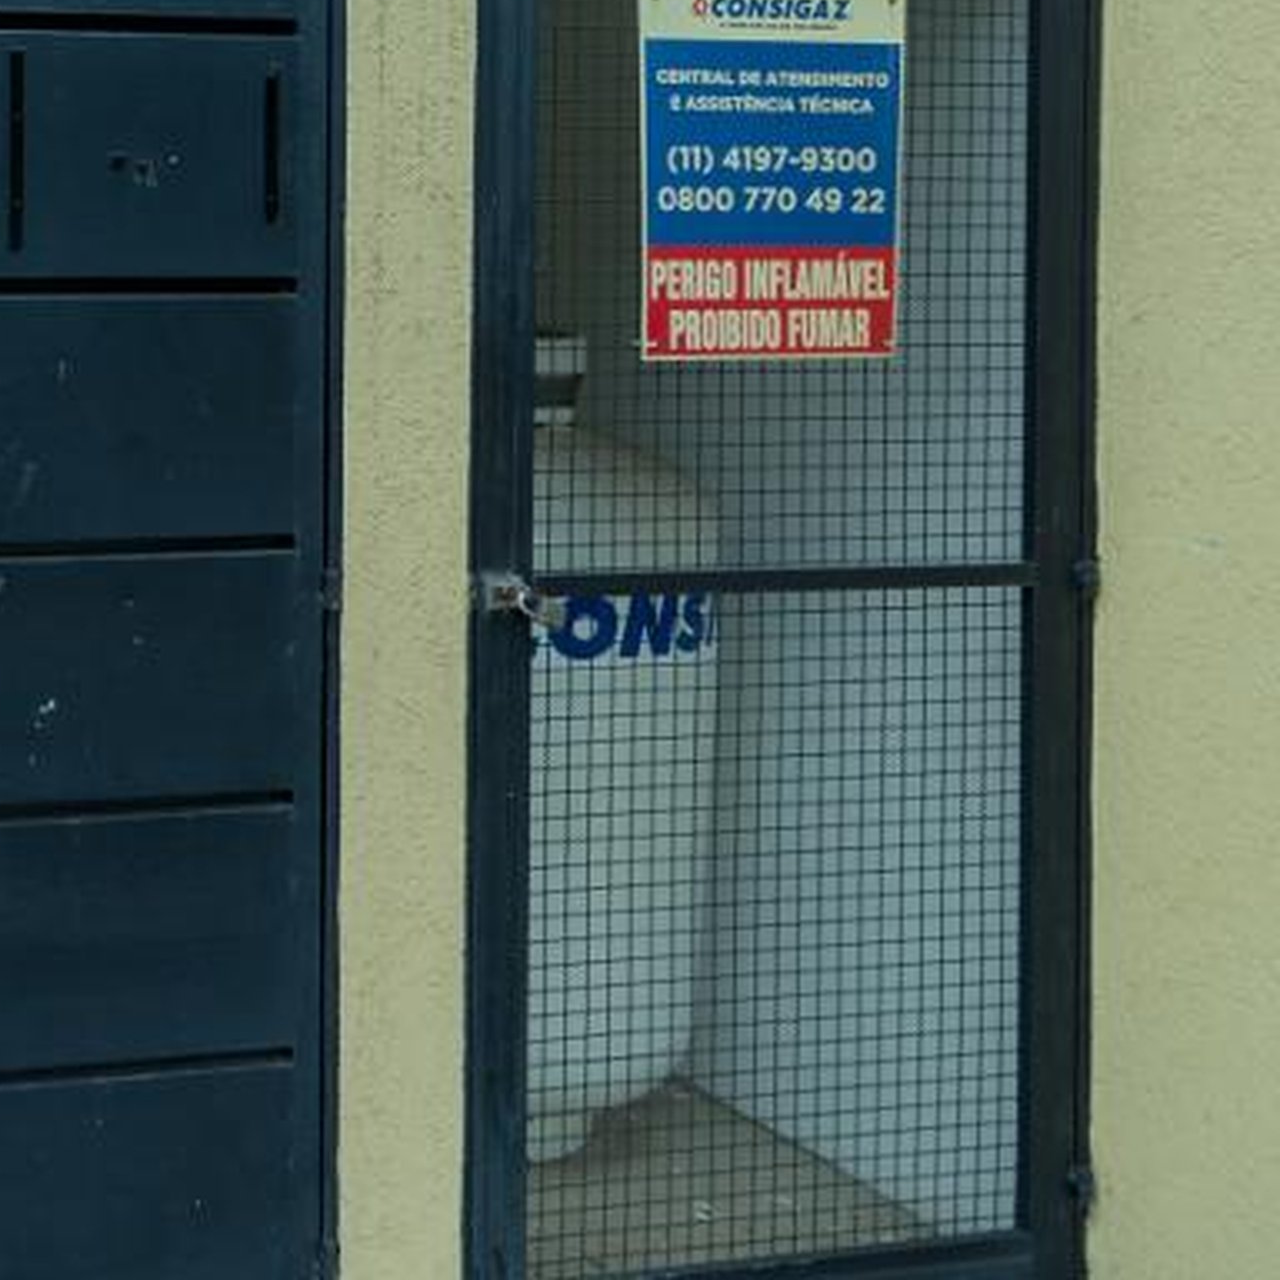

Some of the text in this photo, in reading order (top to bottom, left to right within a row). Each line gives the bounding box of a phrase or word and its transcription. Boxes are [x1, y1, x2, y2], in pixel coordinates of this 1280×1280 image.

[656, 69, 889, 89] CENTRAL DE ATENDIMENTO
[686, 94, 794, 113] ASSISTÊNCIA
[799, 94, 874, 114] TÉCNICA
[666, 146, 876, 174] (11) 4197-9300
[658, 186, 886, 214] 0800 770 49 22
[651, 250, 890, 300] PERIGO INFLAMÁVEL
[669, 308, 870, 350] PROIBIDO FUMAR
